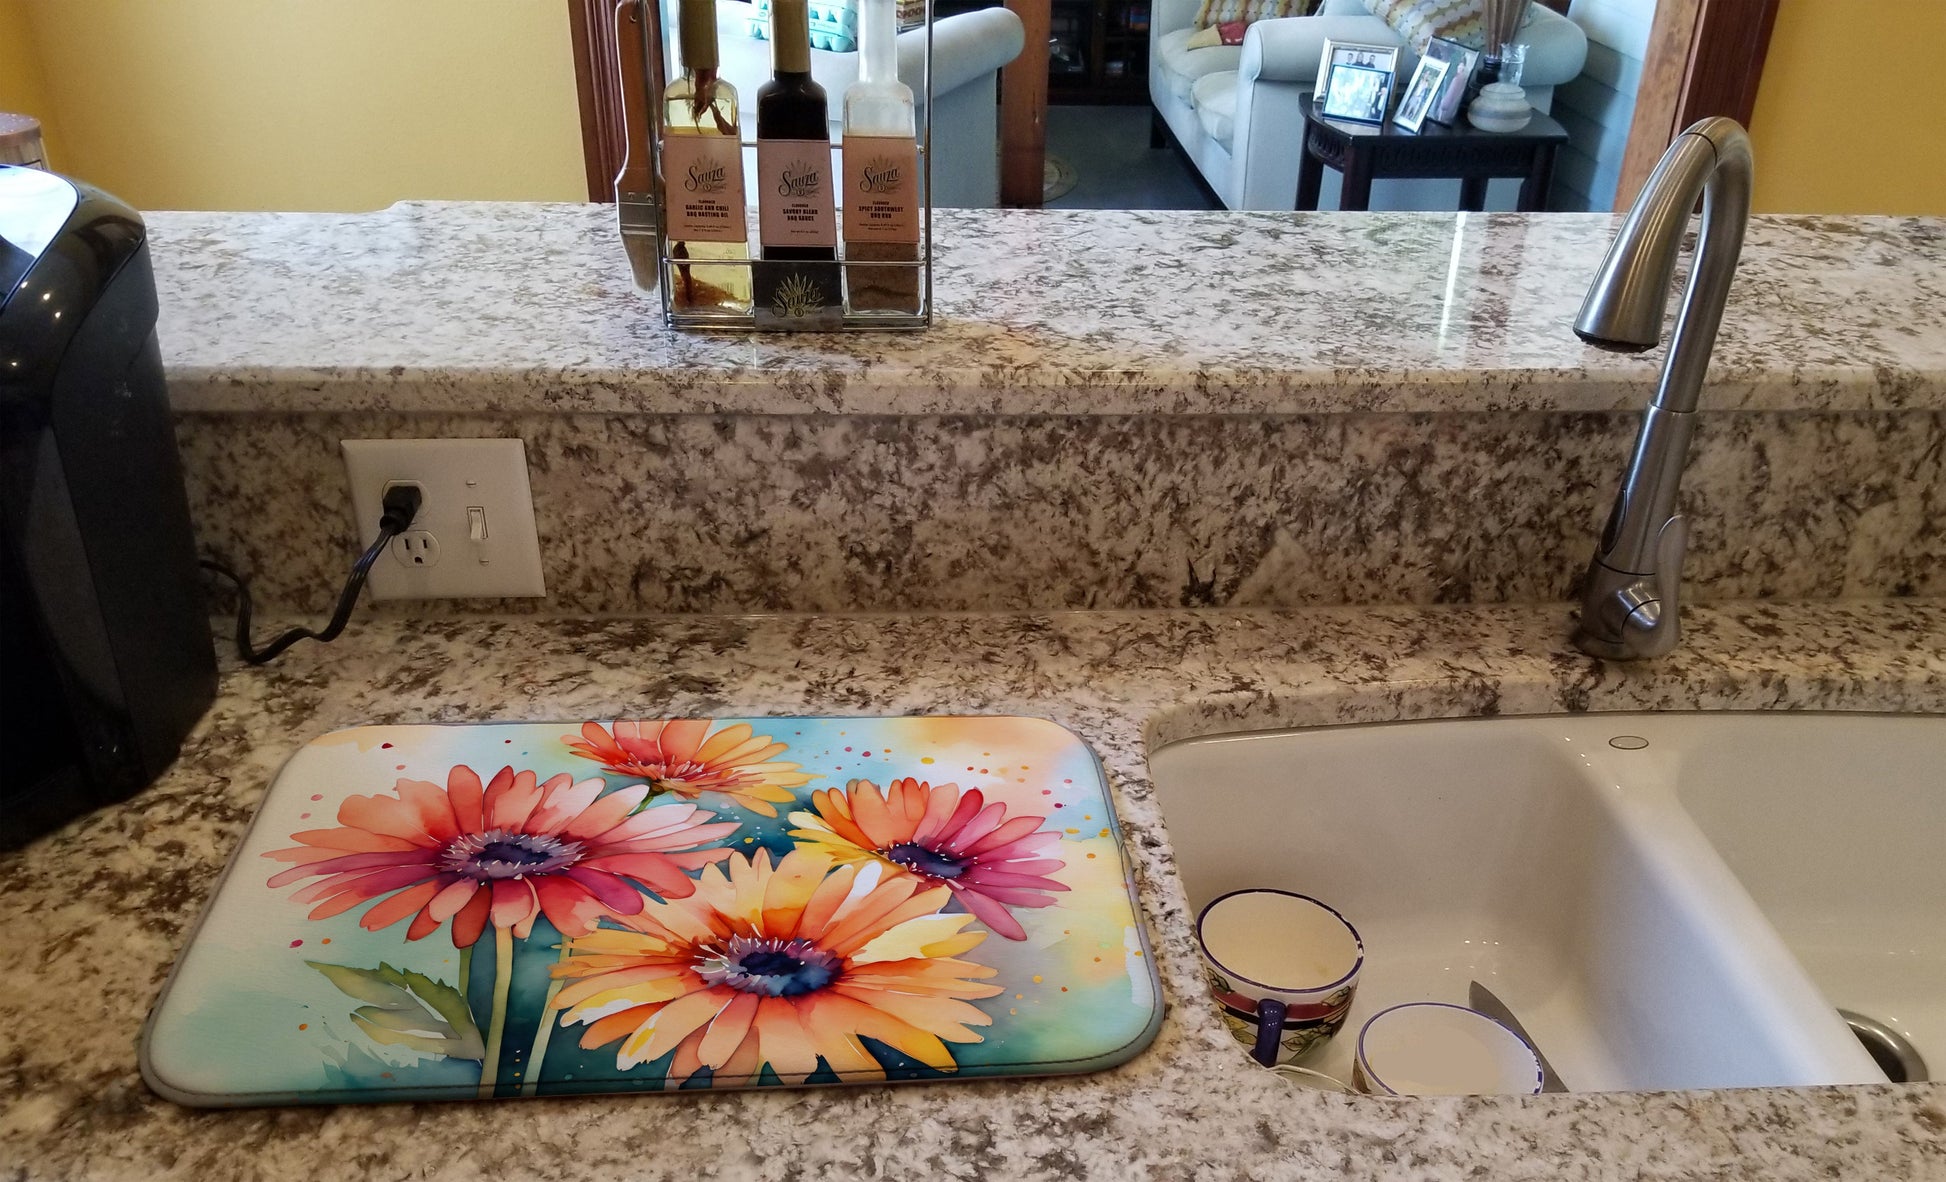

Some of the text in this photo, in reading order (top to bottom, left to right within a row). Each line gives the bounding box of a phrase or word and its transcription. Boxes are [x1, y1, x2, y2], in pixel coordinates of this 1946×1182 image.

[685, 165, 727, 192] Sauza
[778, 171, 819, 197] Sauza
[860, 166, 900, 193] Sauza
